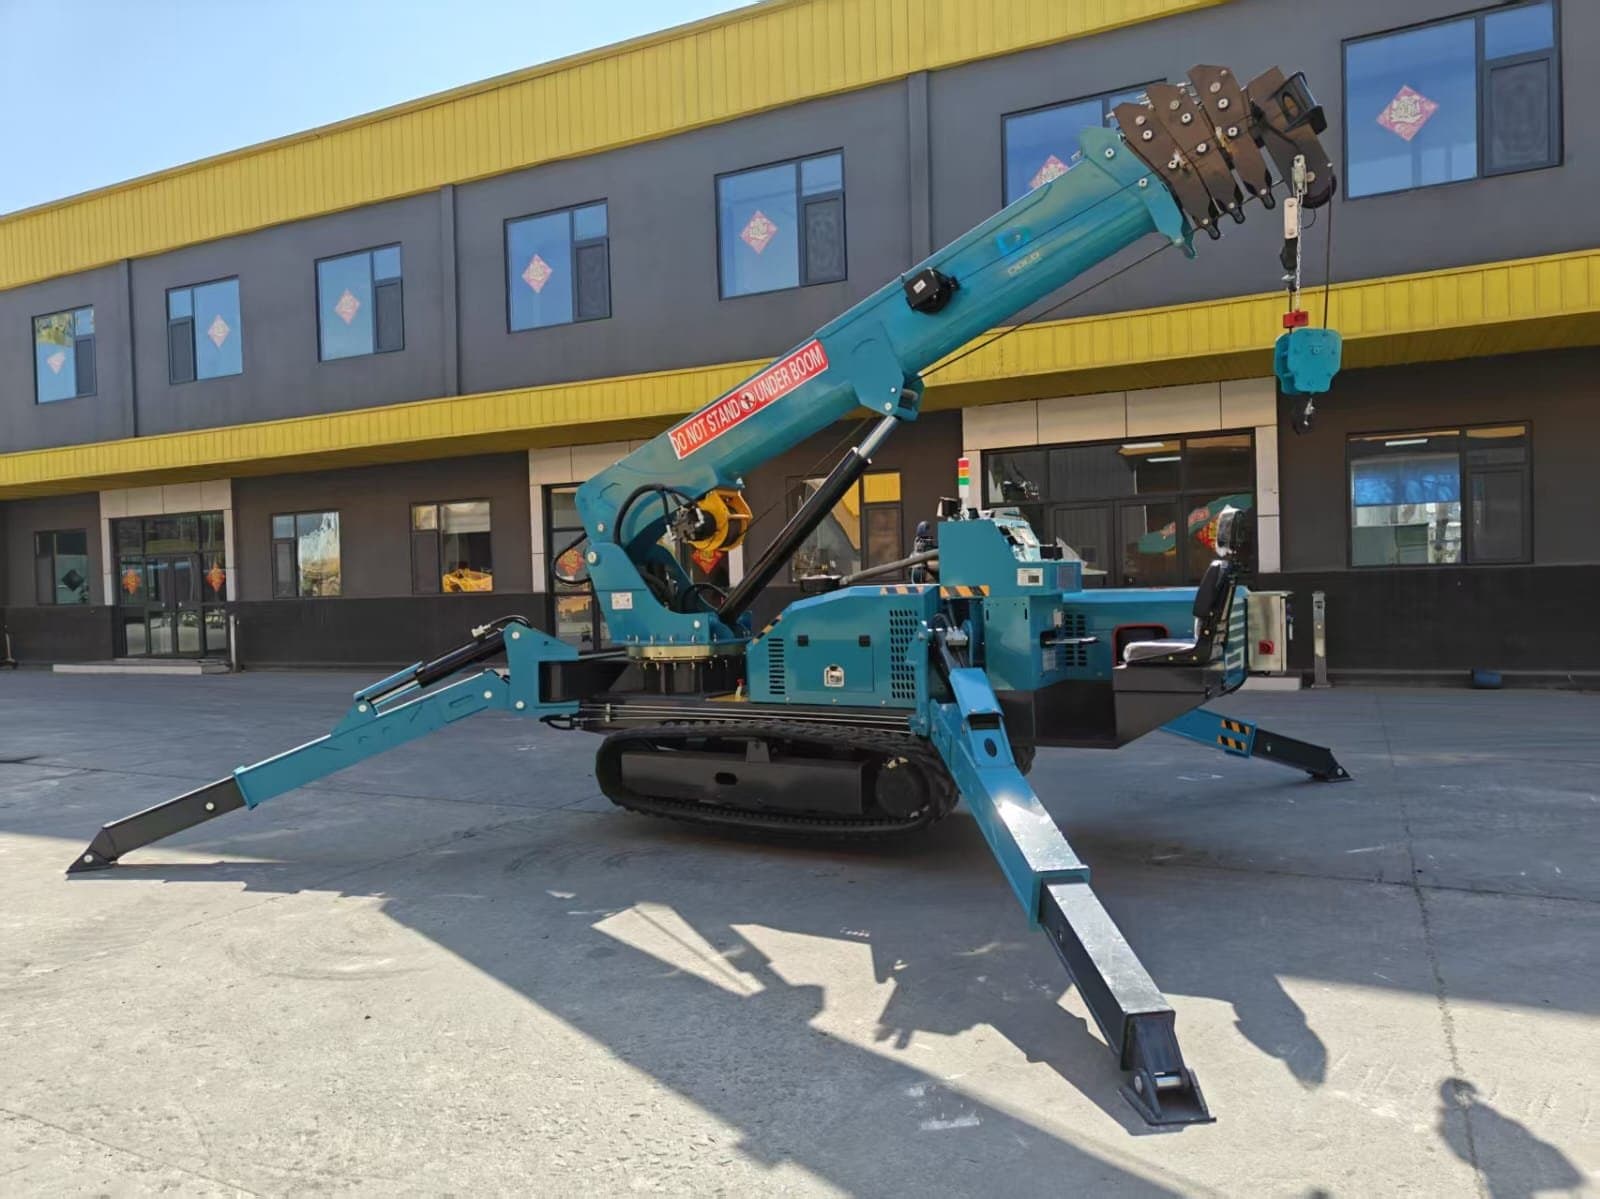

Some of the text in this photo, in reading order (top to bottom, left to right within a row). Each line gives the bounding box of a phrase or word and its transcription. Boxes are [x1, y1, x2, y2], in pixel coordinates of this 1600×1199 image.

[685, 418, 708, 446] NOT
[706, 399, 740, 432] STAND
[753, 367, 792, 402] UNDER
[789, 345, 825, 380] BOOM
